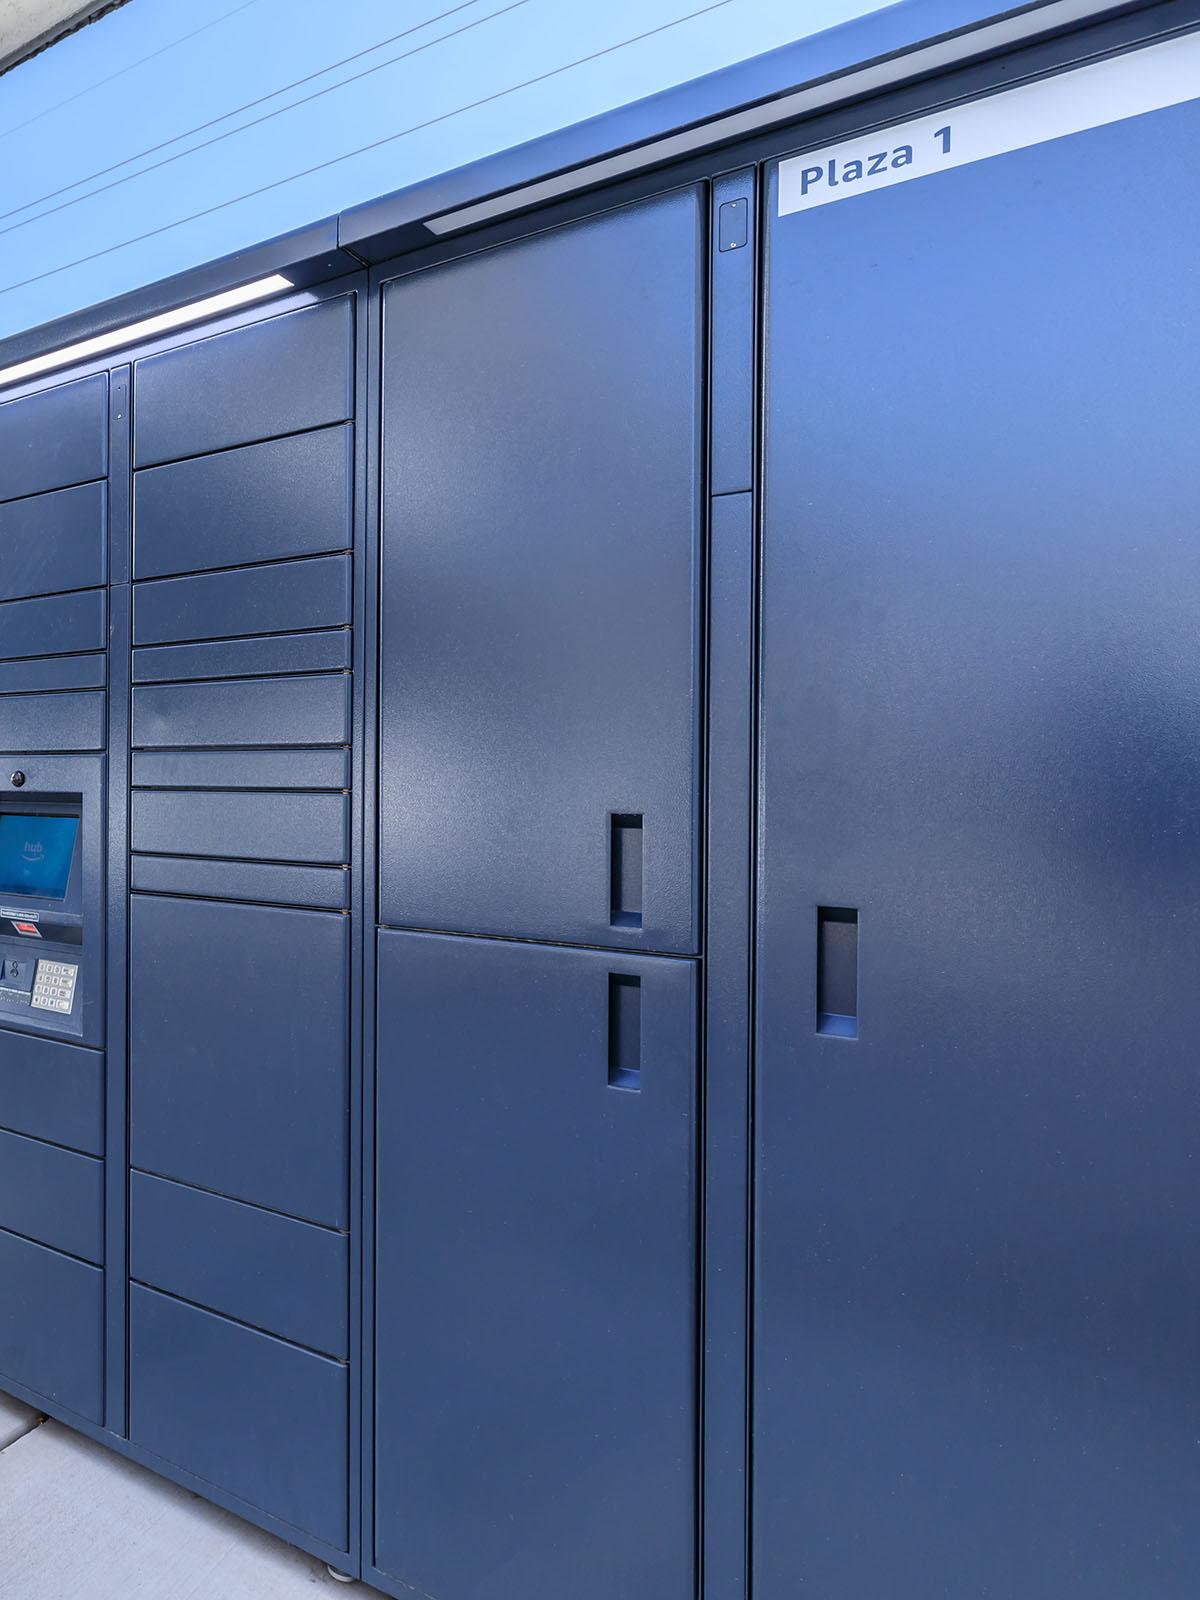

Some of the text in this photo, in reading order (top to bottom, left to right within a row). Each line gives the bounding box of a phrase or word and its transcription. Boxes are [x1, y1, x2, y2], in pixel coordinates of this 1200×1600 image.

[800, 125, 952, 196] Plaza 1
[24, 840, 43, 853] hub
